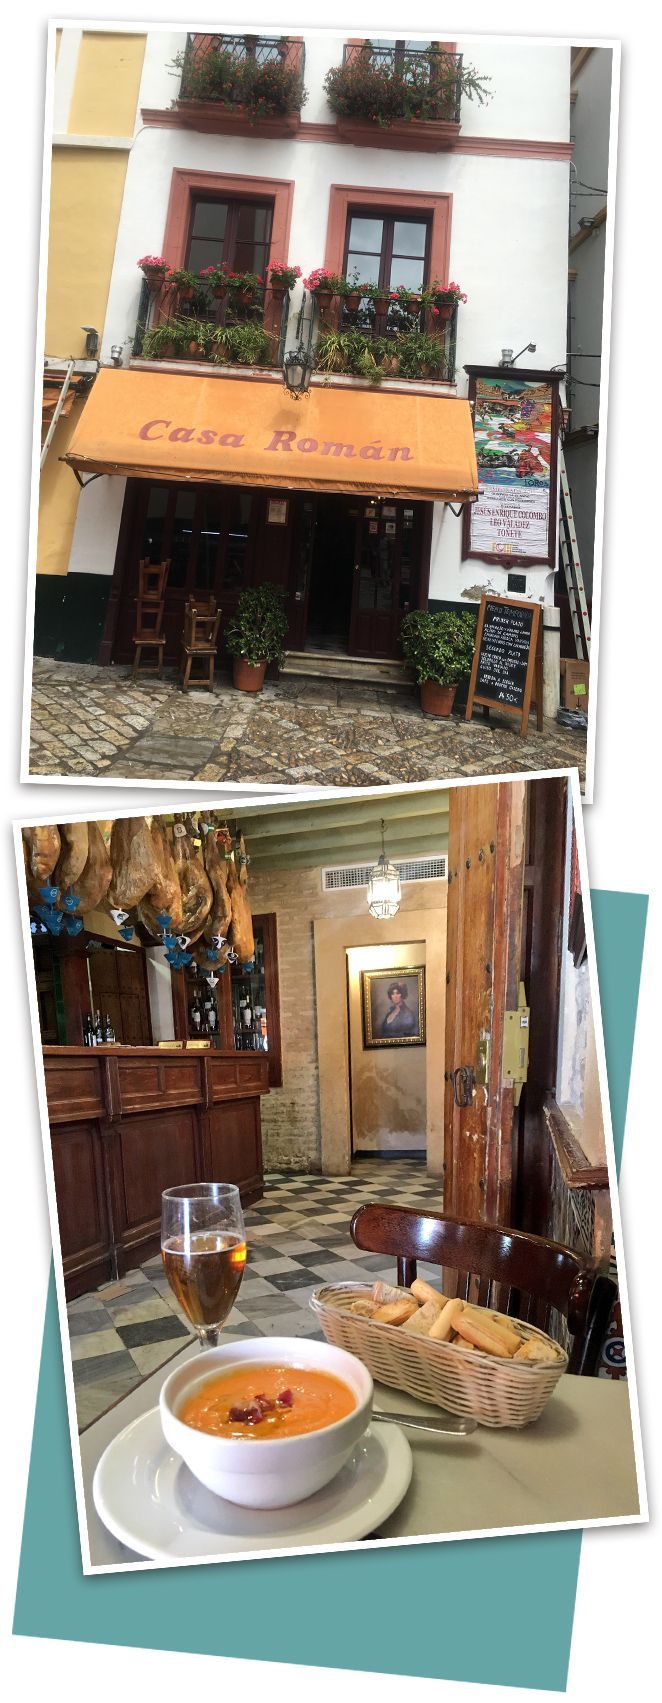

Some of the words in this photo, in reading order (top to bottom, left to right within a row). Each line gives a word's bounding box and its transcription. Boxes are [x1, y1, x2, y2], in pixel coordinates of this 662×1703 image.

[138, 419, 245, 448] Casa
[264, 430, 415, 461] Román
[491, 508, 518, 519] ENRIQUE
[519, 510, 547, 520] COLOMBO
[490, 518, 502, 527] LEO
[503, 518, 530, 529] VALADEZ
